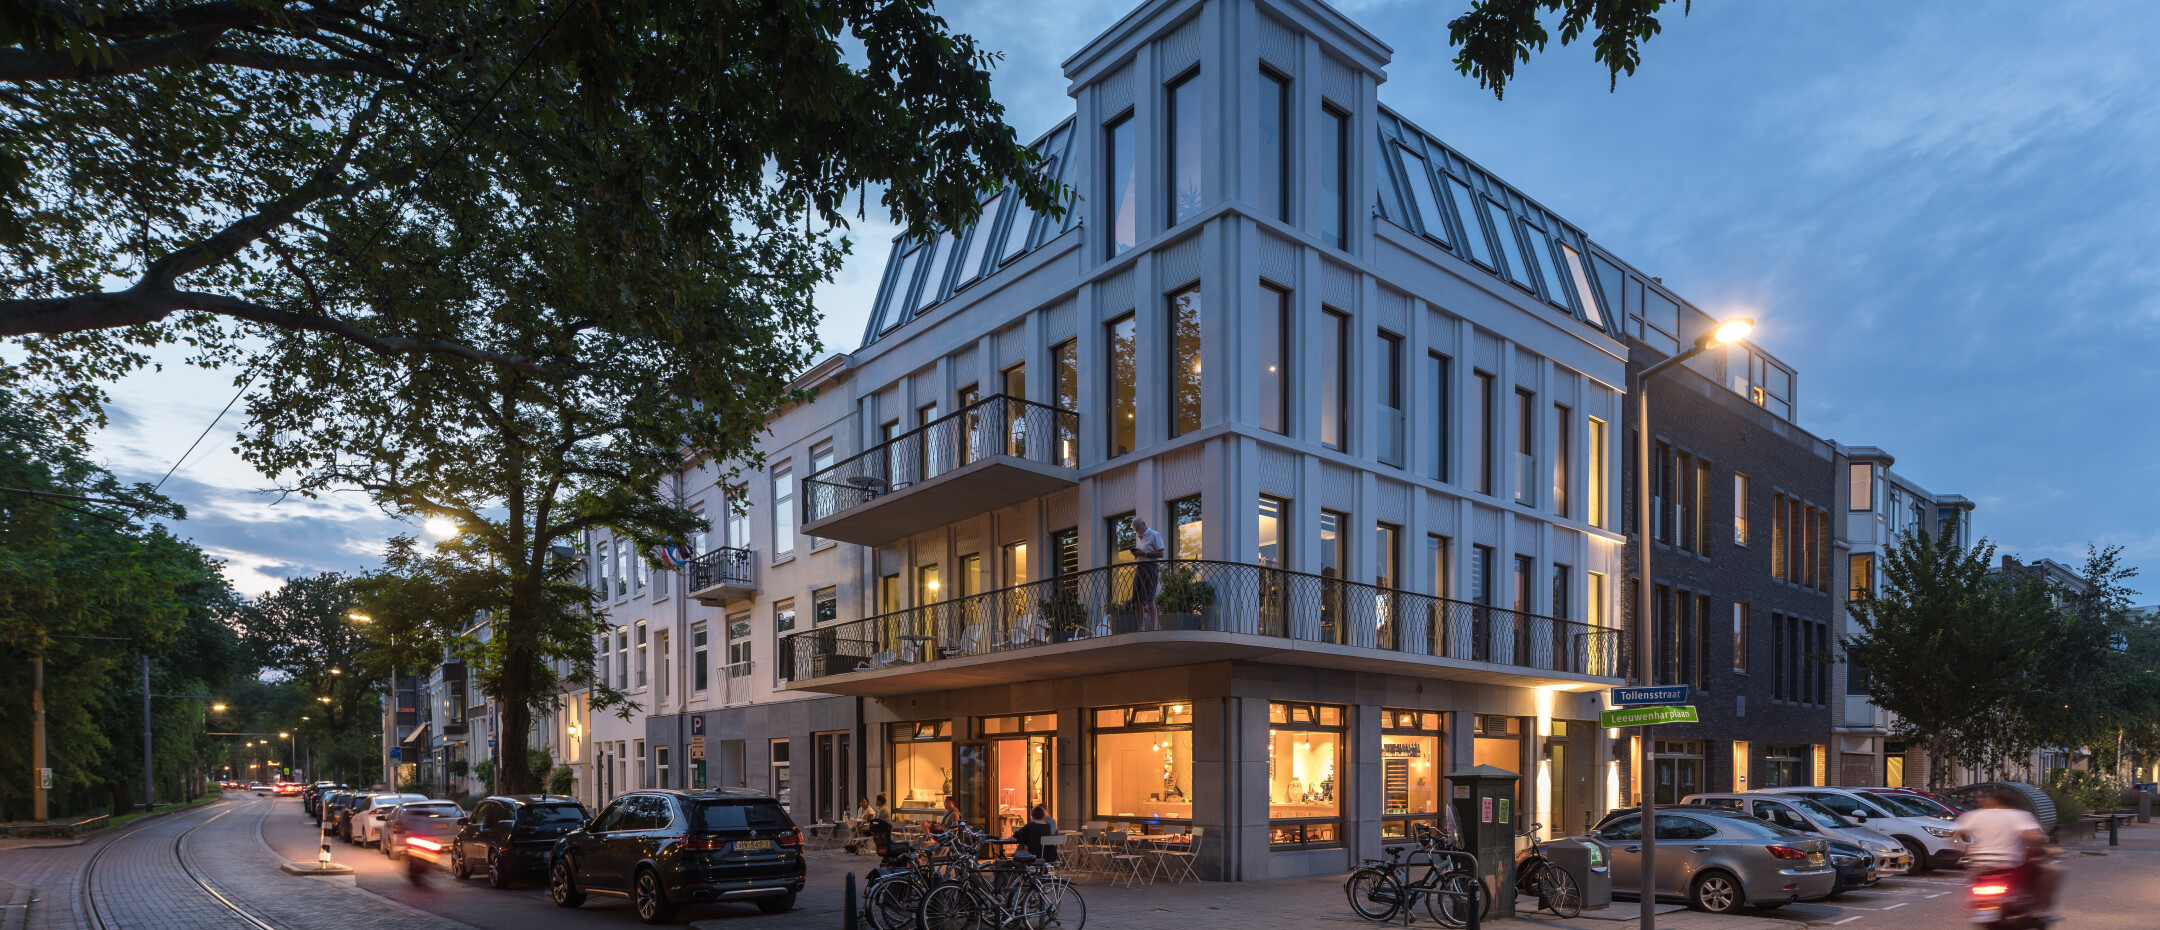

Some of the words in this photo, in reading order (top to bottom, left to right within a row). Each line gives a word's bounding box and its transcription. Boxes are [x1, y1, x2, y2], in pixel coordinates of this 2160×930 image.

[1620, 690, 1680, 700] Tollensstraat
[1611, 710, 1690, 723] Leeuwenharplaan
[694, 717, 701, 733] P
